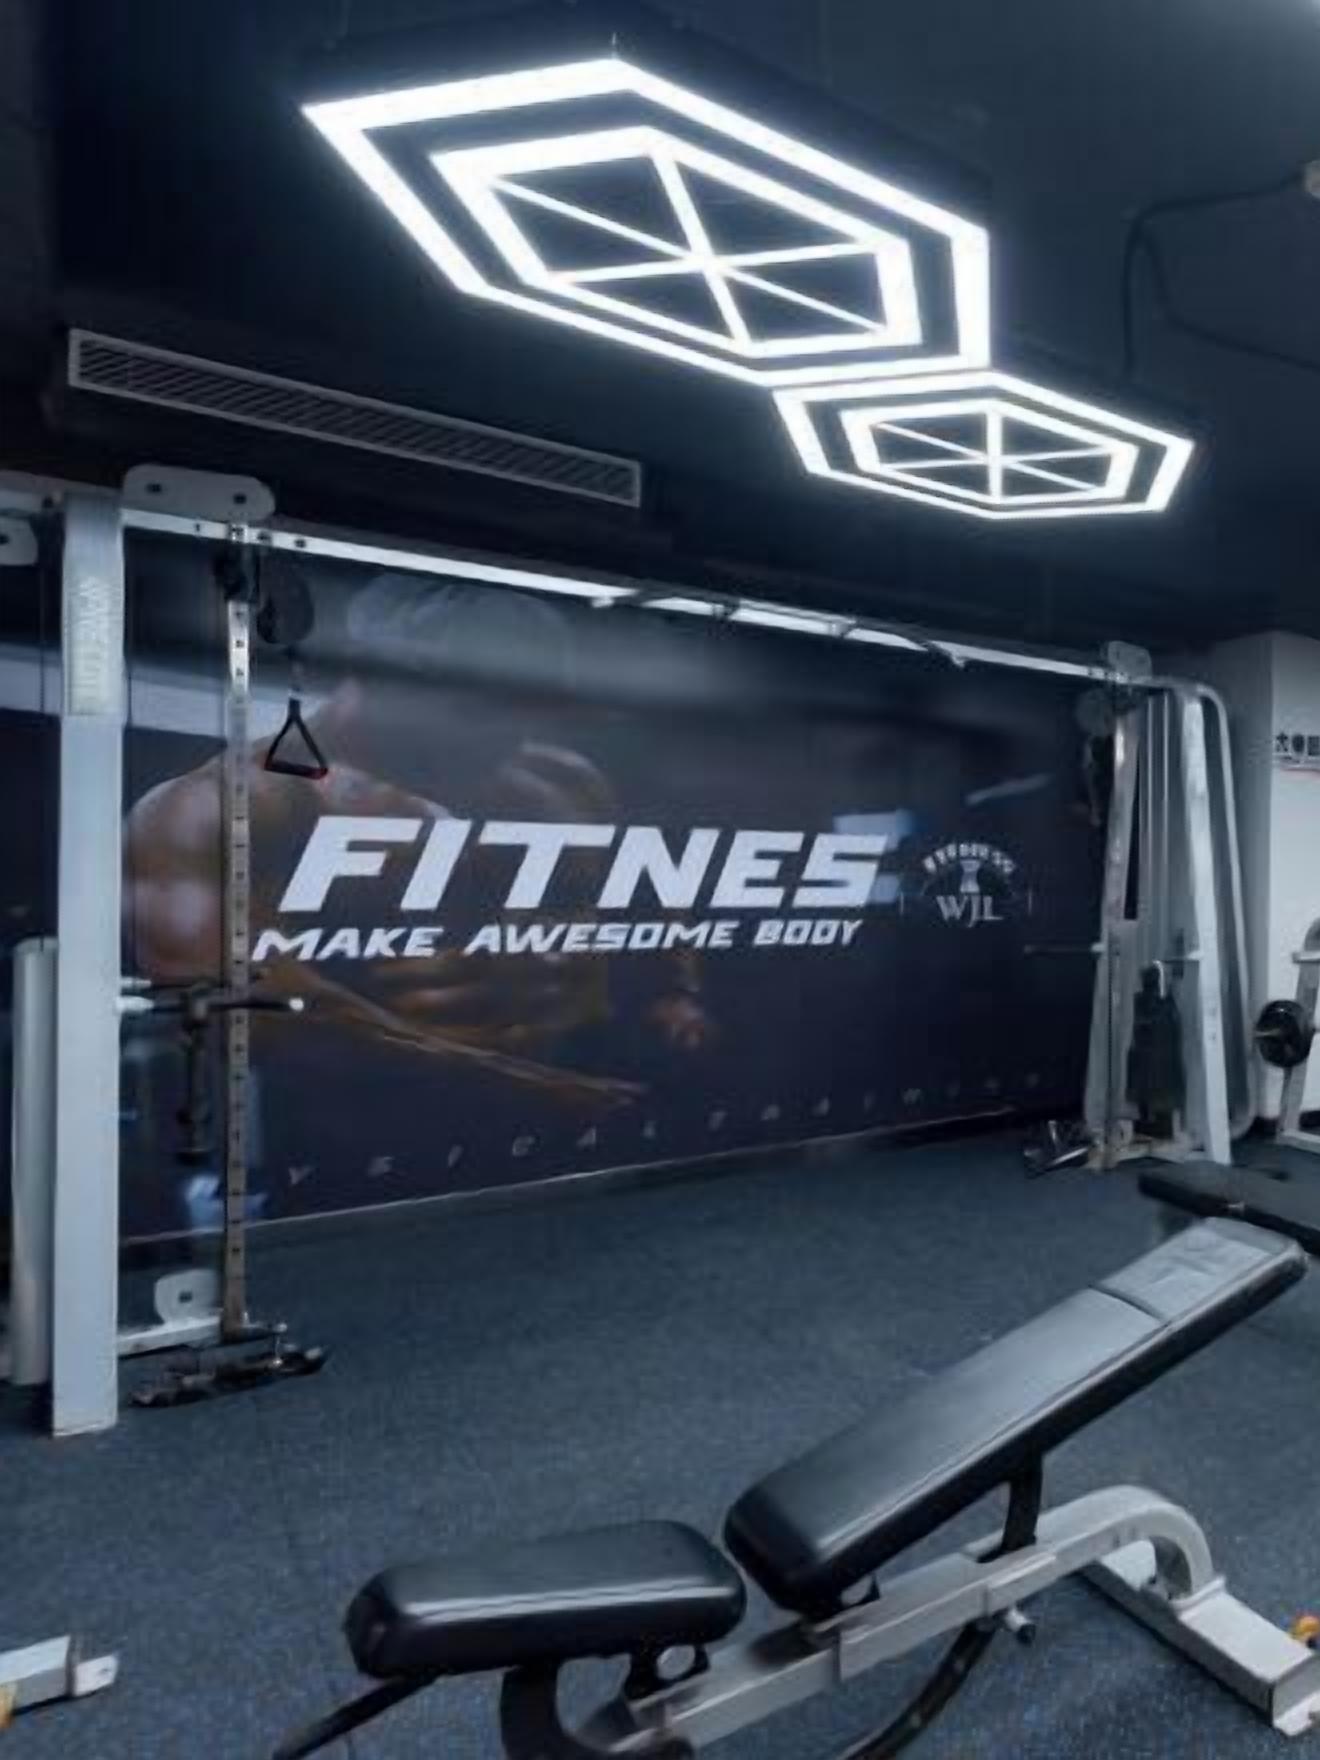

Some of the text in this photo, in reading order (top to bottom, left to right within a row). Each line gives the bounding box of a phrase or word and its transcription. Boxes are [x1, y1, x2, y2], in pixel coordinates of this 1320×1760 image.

[278, 816, 888, 911] FITNES
[936, 895, 1004, 928] WJL
[252, 918, 864, 961] MAKE AWESOME BODY
